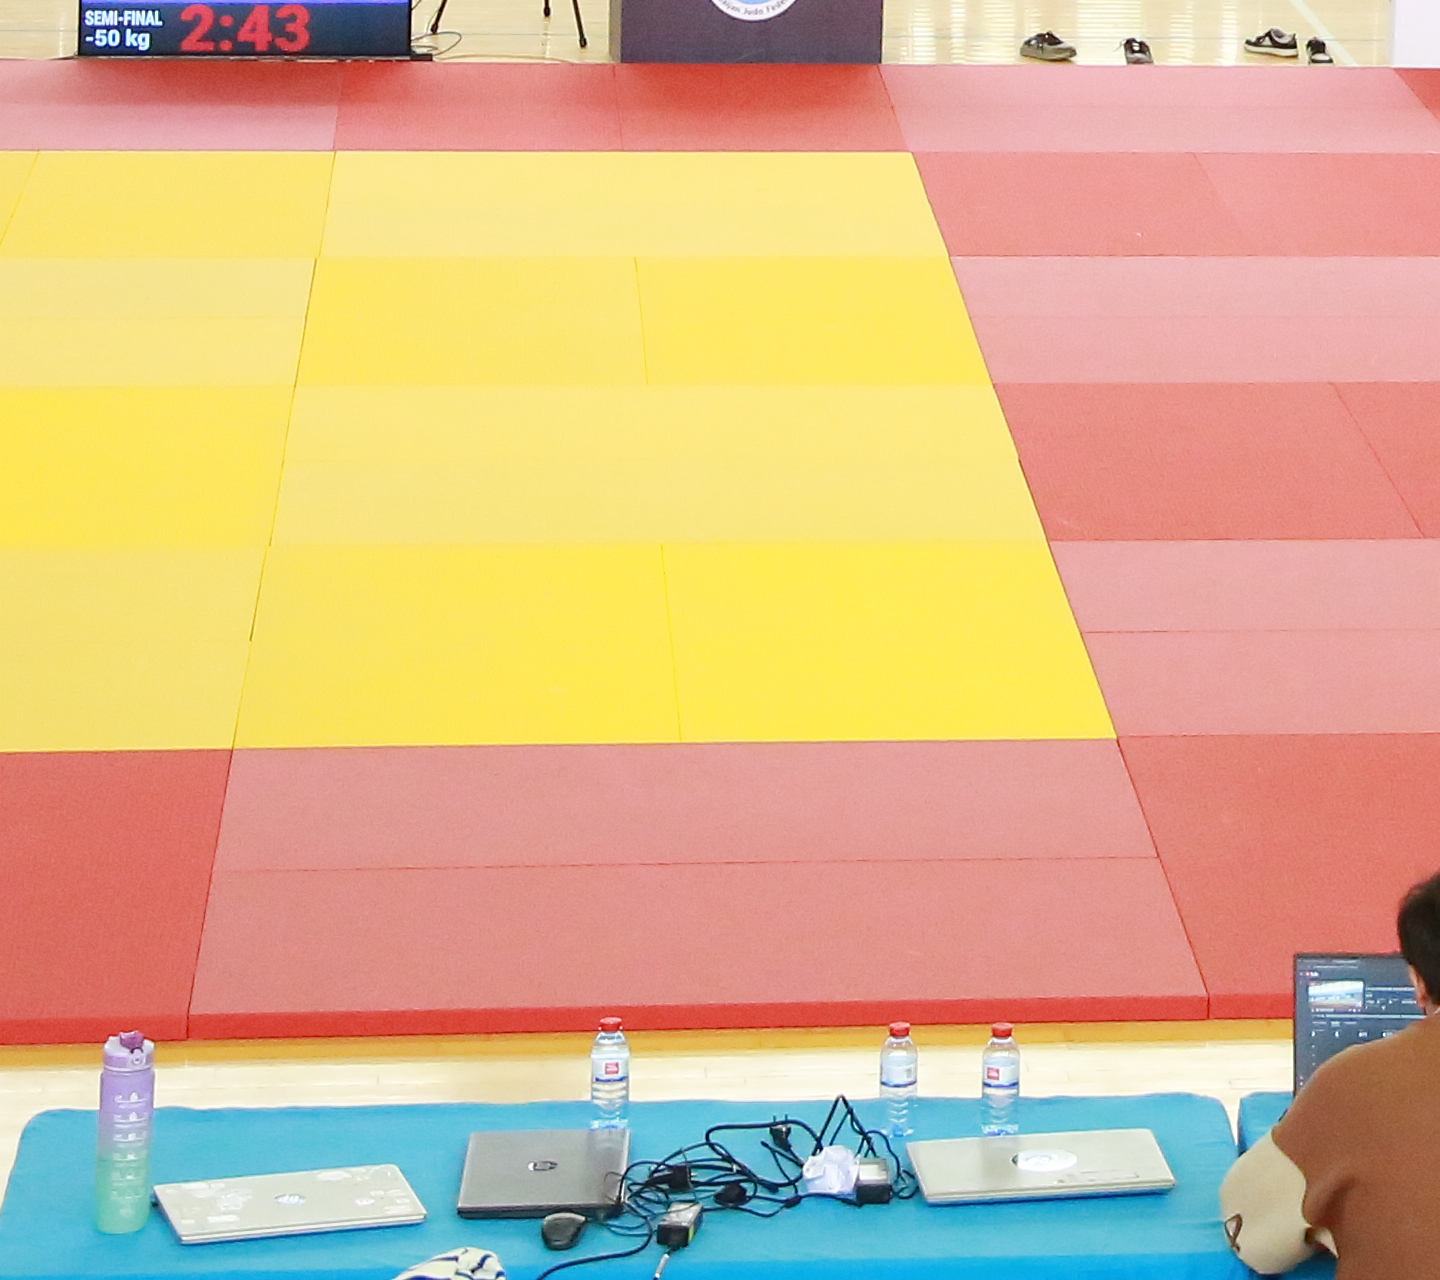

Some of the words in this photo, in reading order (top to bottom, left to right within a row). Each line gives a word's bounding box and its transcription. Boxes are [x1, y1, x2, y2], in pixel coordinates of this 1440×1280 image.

[84, 9, 163, 26] SEMI-FINAL
[179, 3, 311, 52] 2:43
[85, 28, 121, 48] -50
[125, 28, 151, 51] kg
